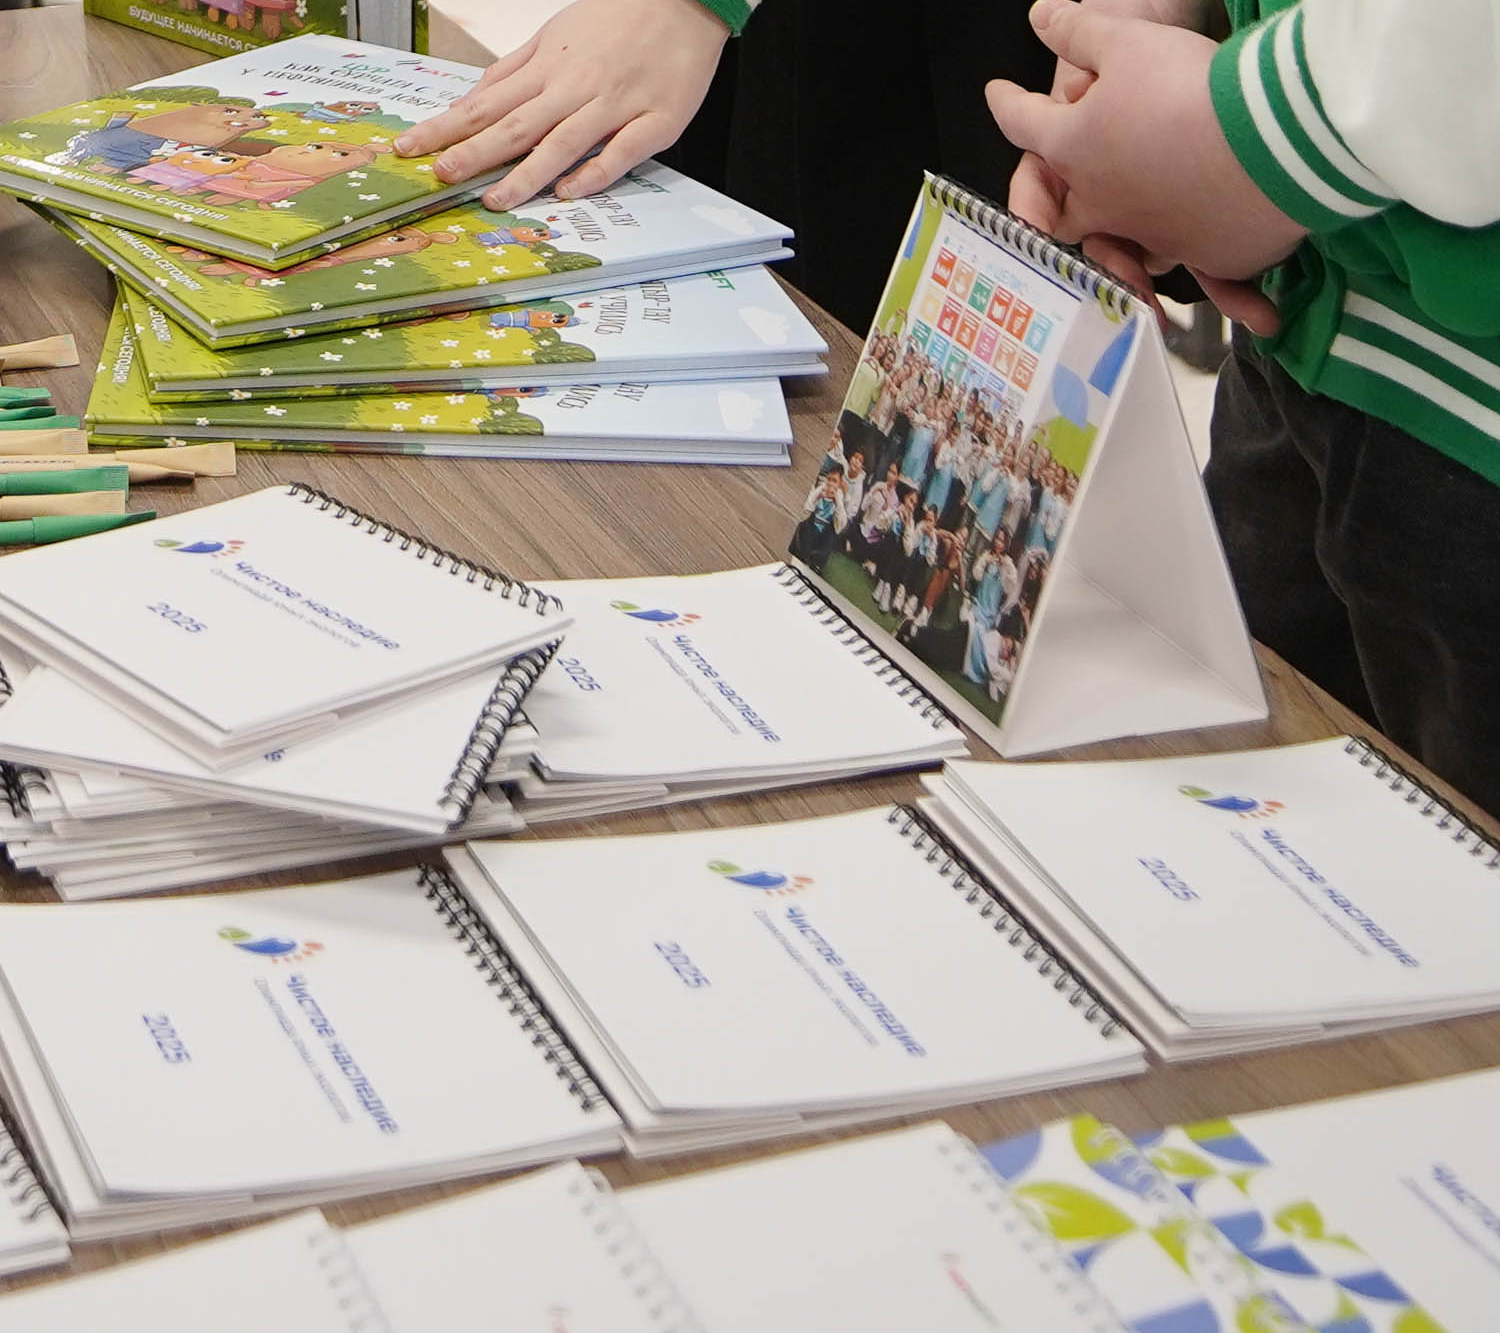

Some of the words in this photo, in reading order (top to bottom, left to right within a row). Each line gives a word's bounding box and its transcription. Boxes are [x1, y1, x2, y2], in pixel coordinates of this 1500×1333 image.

[128, 5, 175, 30] БУДУЩЕЕ
[176, 21, 243, 53] НАЧИНАЕТСЯ
[145, 601, 208, 634] 2025
[235, 560, 303, 600] Чистое
[300, 598, 401, 651] наследие
[557, 656, 604, 693] 2025
[672, 633, 720, 680] Чистое
[713, 679, 782, 744] наследие
[1136, 856, 1202, 902] 2025
[1261, 827, 1327, 884] Чистое
[1323, 886, 1421, 968] наследие
[653, 941, 712, 989] 2025
[785, 905, 845, 968] Чистое
[841, 968, 928, 1058] наследие
[142, 1012, 192, 1064] 2025
[286, 971, 337, 1039] Чистое
[327, 1037, 400, 1135] наследие
